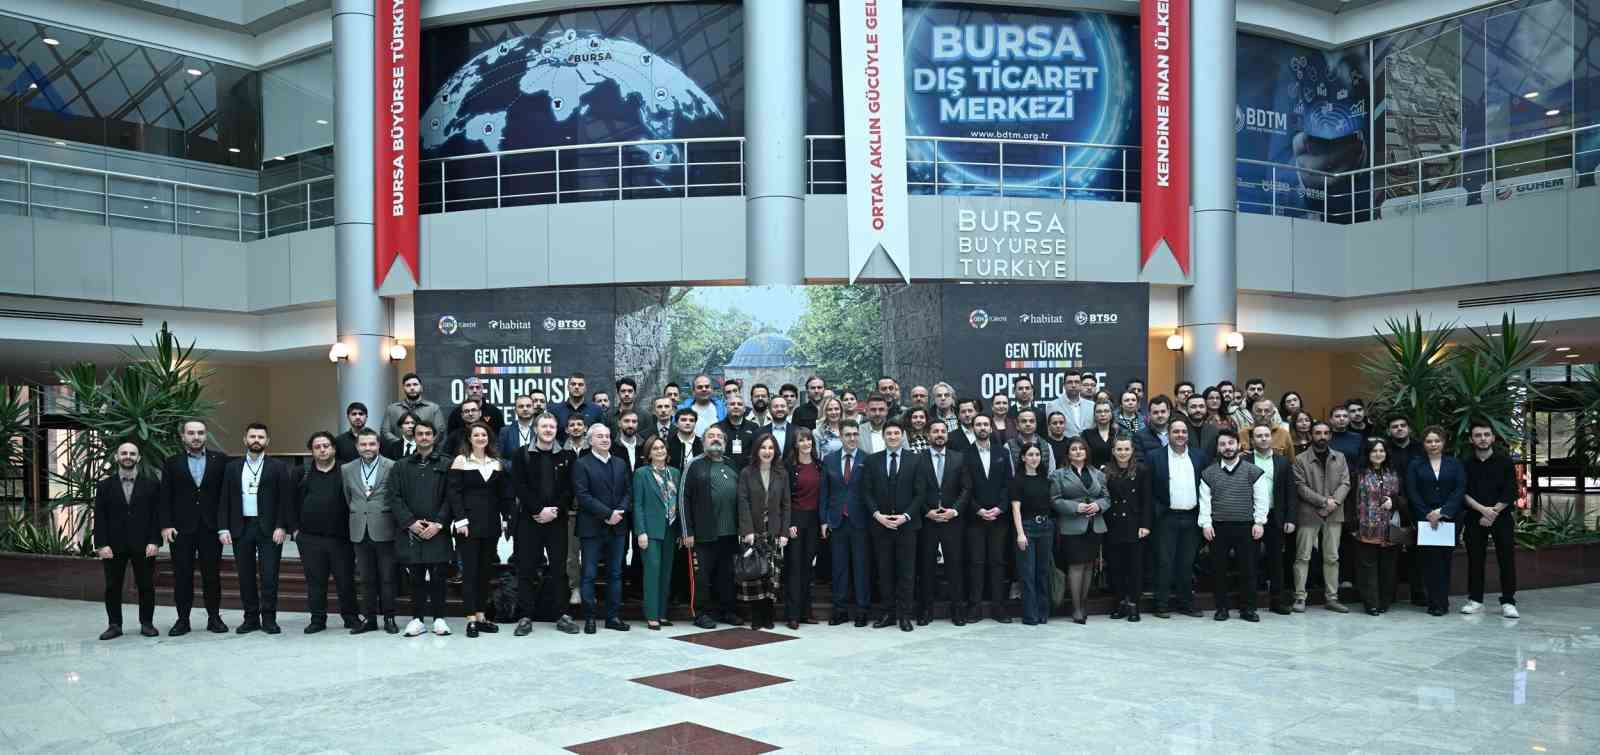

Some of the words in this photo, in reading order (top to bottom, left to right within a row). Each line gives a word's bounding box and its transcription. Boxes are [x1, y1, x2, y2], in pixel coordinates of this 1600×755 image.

[1154, 0, 1169, 50] ÜLKE
[932, 25, 1085, 60] BURSA
[574, 52, 612, 62] BURSA
[864, 34, 880, 113] GÜCÜYLE
[913, 67, 967, 97] DIŞ
[973, 59, 1099, 91] TİCARET
[1157, 55, 1169, 101] İNAN
[390, 66, 405, 150] BÜYÜRSE
[940, 90, 1074, 122] MERKEZİ
[1246, 106, 1287, 130] BDTM
[869, 118, 882, 168] AKLIN
[970, 130, 1049, 141] www.bdtm.org.tr
[1157, 105, 1169, 187] KENDİNE
[392, 155, 404, 216] BURSA
[871, 173, 885, 230] ORTAK
[959, 209, 1065, 233] BURSA
[959, 237, 1066, 255] BÜYÜRSE
[959, 259, 1066, 278] TÜRKİYE
[499, 319, 531, 329] habitat
[557, 319, 586, 328] BTSO
[1030, 313, 1064, 324] habitat
[1089, 313, 1118, 322] BTSO
[474, 348, 499, 364] GEN
[502, 346, 552, 364] TÜRKİYE
[1005, 342, 1029, 359] GEN
[1032, 340, 1083, 358] TÜRKİYE
[451, 379, 504, 404] OEN
[981, 373, 1034, 399] OPE
[1040, 372, 1107, 399] HOE
